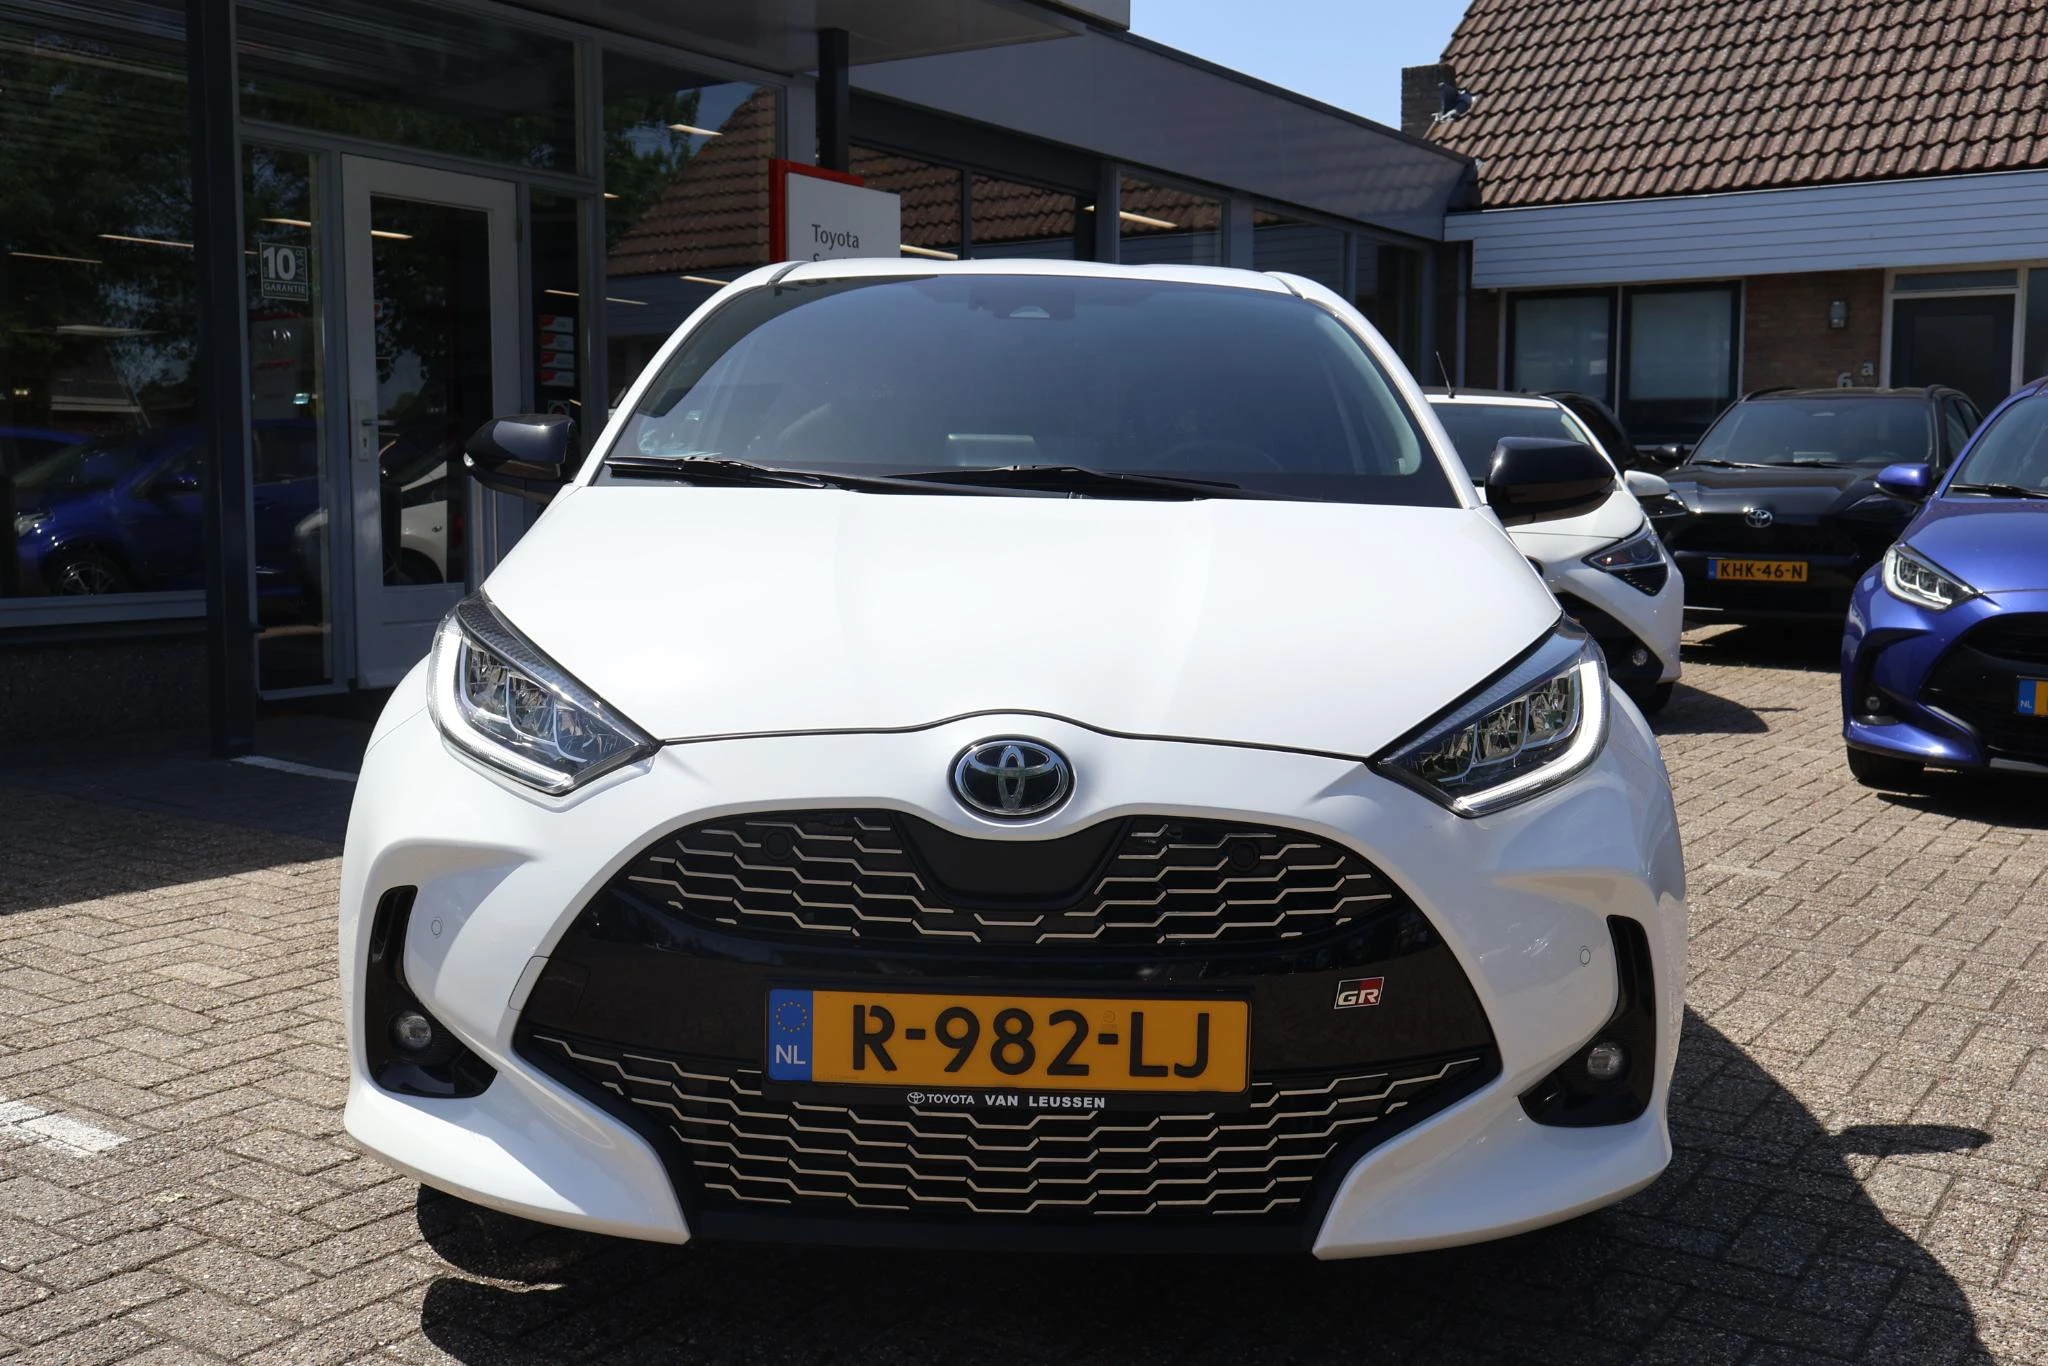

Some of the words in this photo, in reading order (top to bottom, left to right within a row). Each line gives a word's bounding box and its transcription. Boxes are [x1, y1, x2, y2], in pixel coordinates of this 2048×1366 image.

[811, 224, 860, 250] Toyota
[263, 246, 296, 281] 10
[264, 282, 306, 294] GARANTIE
[1720, 562, 1803, 580] KHK-46-N
[1337, 988, 1380, 1006] GR
[852, 1002, 1210, 1079] R-982-LJ
[775, 1044, 806, 1065] NL
[927, 1093, 975, 1105] TOYOTA
[984, 1094, 1019, 1107] VAN
[1028, 1095, 1106, 1109] LEUSSEN
